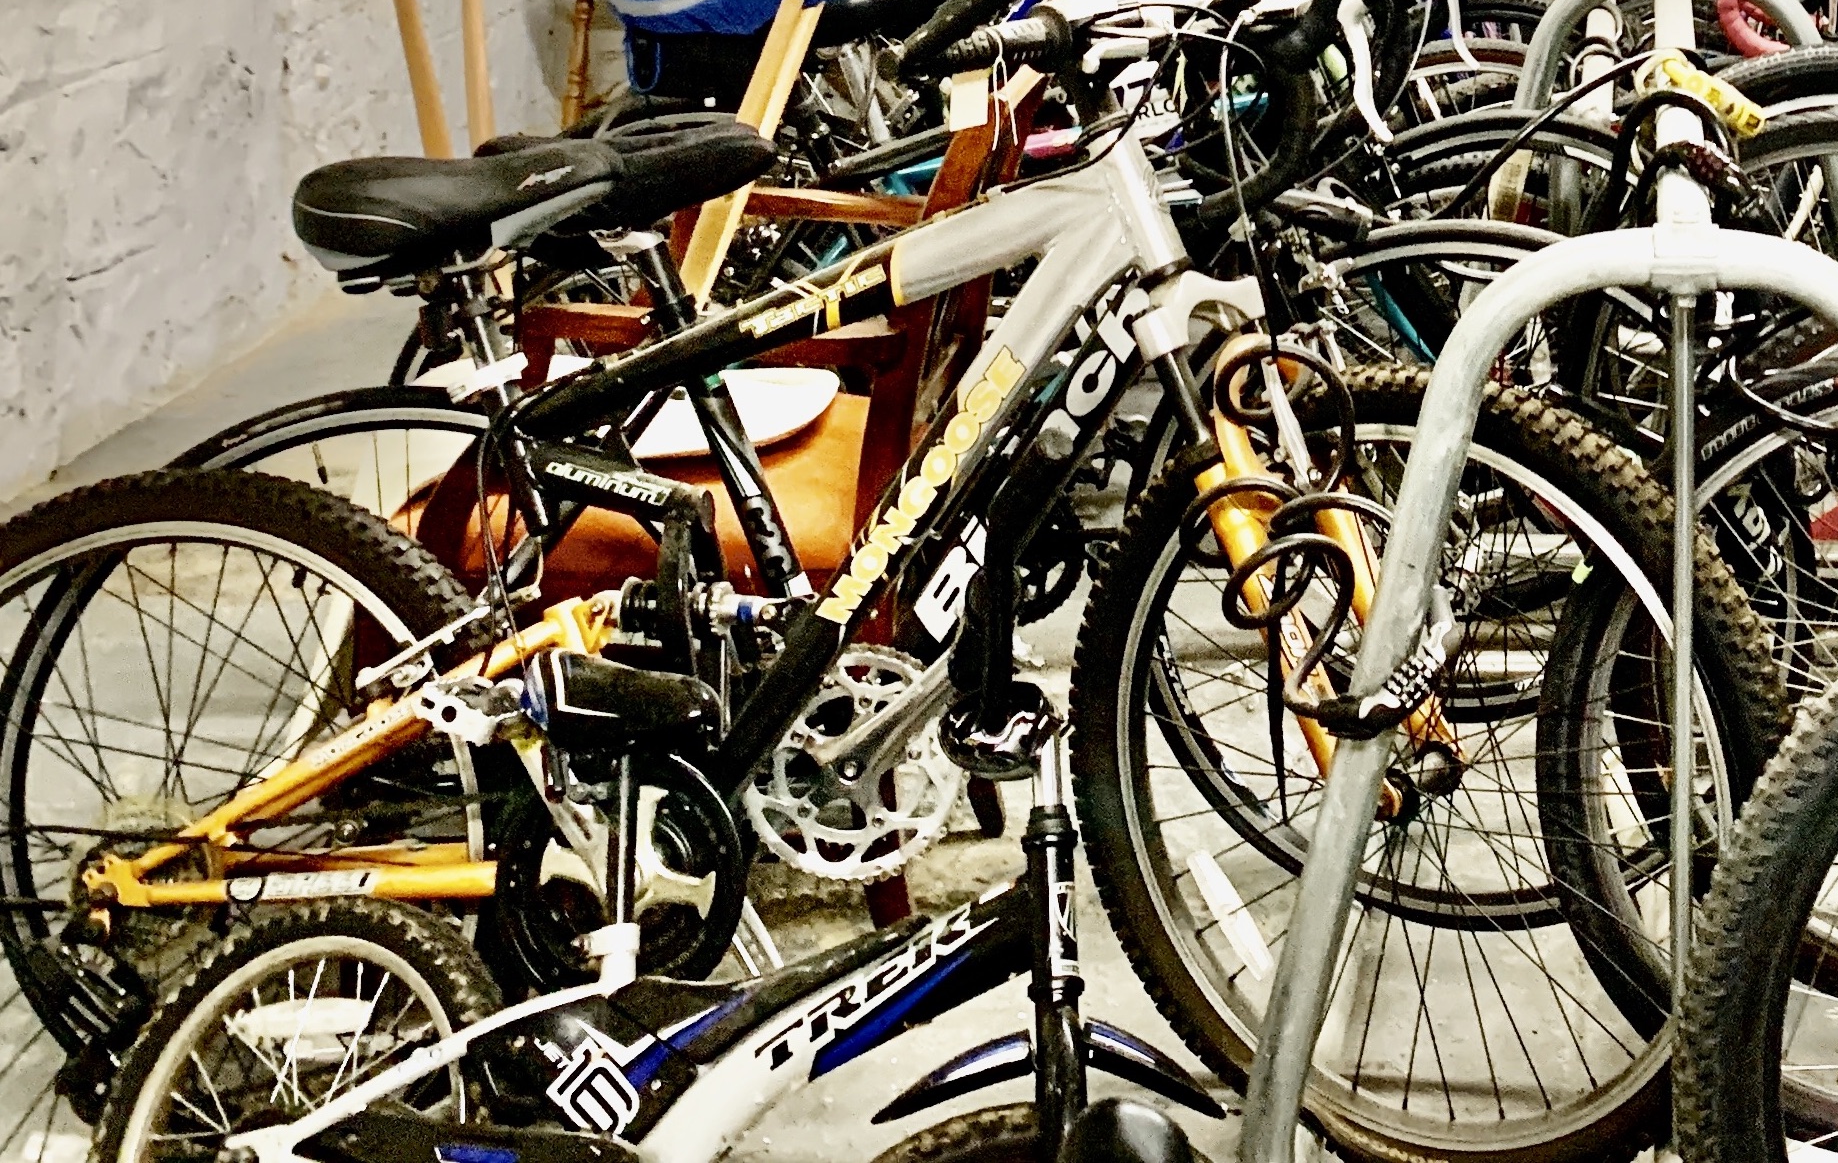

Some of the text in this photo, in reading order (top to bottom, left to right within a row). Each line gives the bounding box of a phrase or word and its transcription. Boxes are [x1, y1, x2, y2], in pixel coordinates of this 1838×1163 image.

[545, 461, 666, 507] aluminum
[814, 344, 1028, 625] MONGOOSE
[913, 286, 1151, 644] Binch
[754, 900, 980, 1072] TREK
